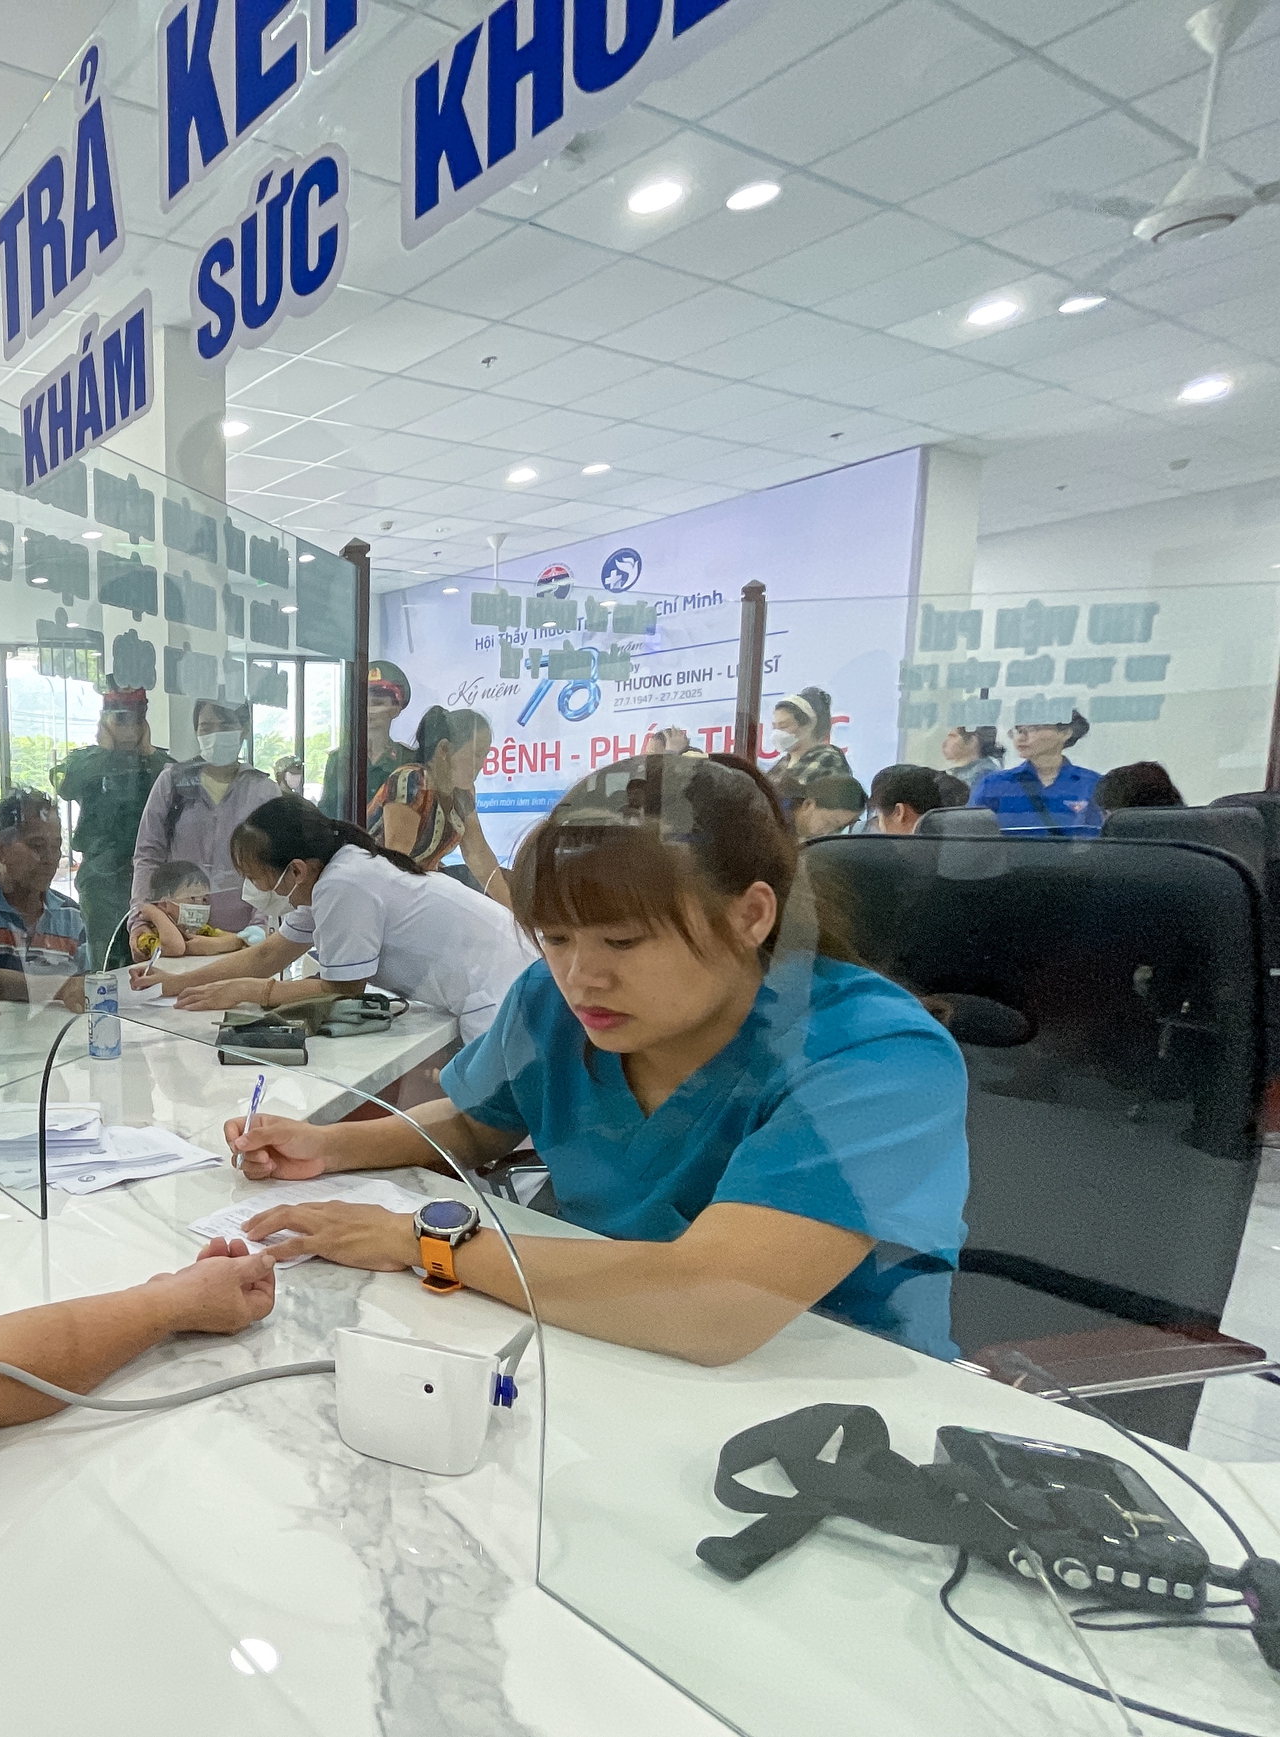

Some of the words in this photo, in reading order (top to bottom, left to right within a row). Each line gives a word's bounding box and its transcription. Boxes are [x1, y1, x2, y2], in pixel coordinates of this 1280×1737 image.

[167, 0, 357, 200] KE
[23, 308, 146, 488] KHÁM
[198, 156, 338, 360] SỨC
[654, 595, 679, 616] Chí
[683, 590, 723, 611] Minh
[475, 635, 495, 652] Hội
[615, 673, 671, 692] THƯƠNG
[676, 667, 713, 685] BINH
[764, 655, 782, 674] SĨ
[448, 677, 484, 706] Kỷ
[482, 682, 520, 701] niệm
[660, 688, 703, 702] 27.7.2025
[482, 737, 560, 782] BỆNH
